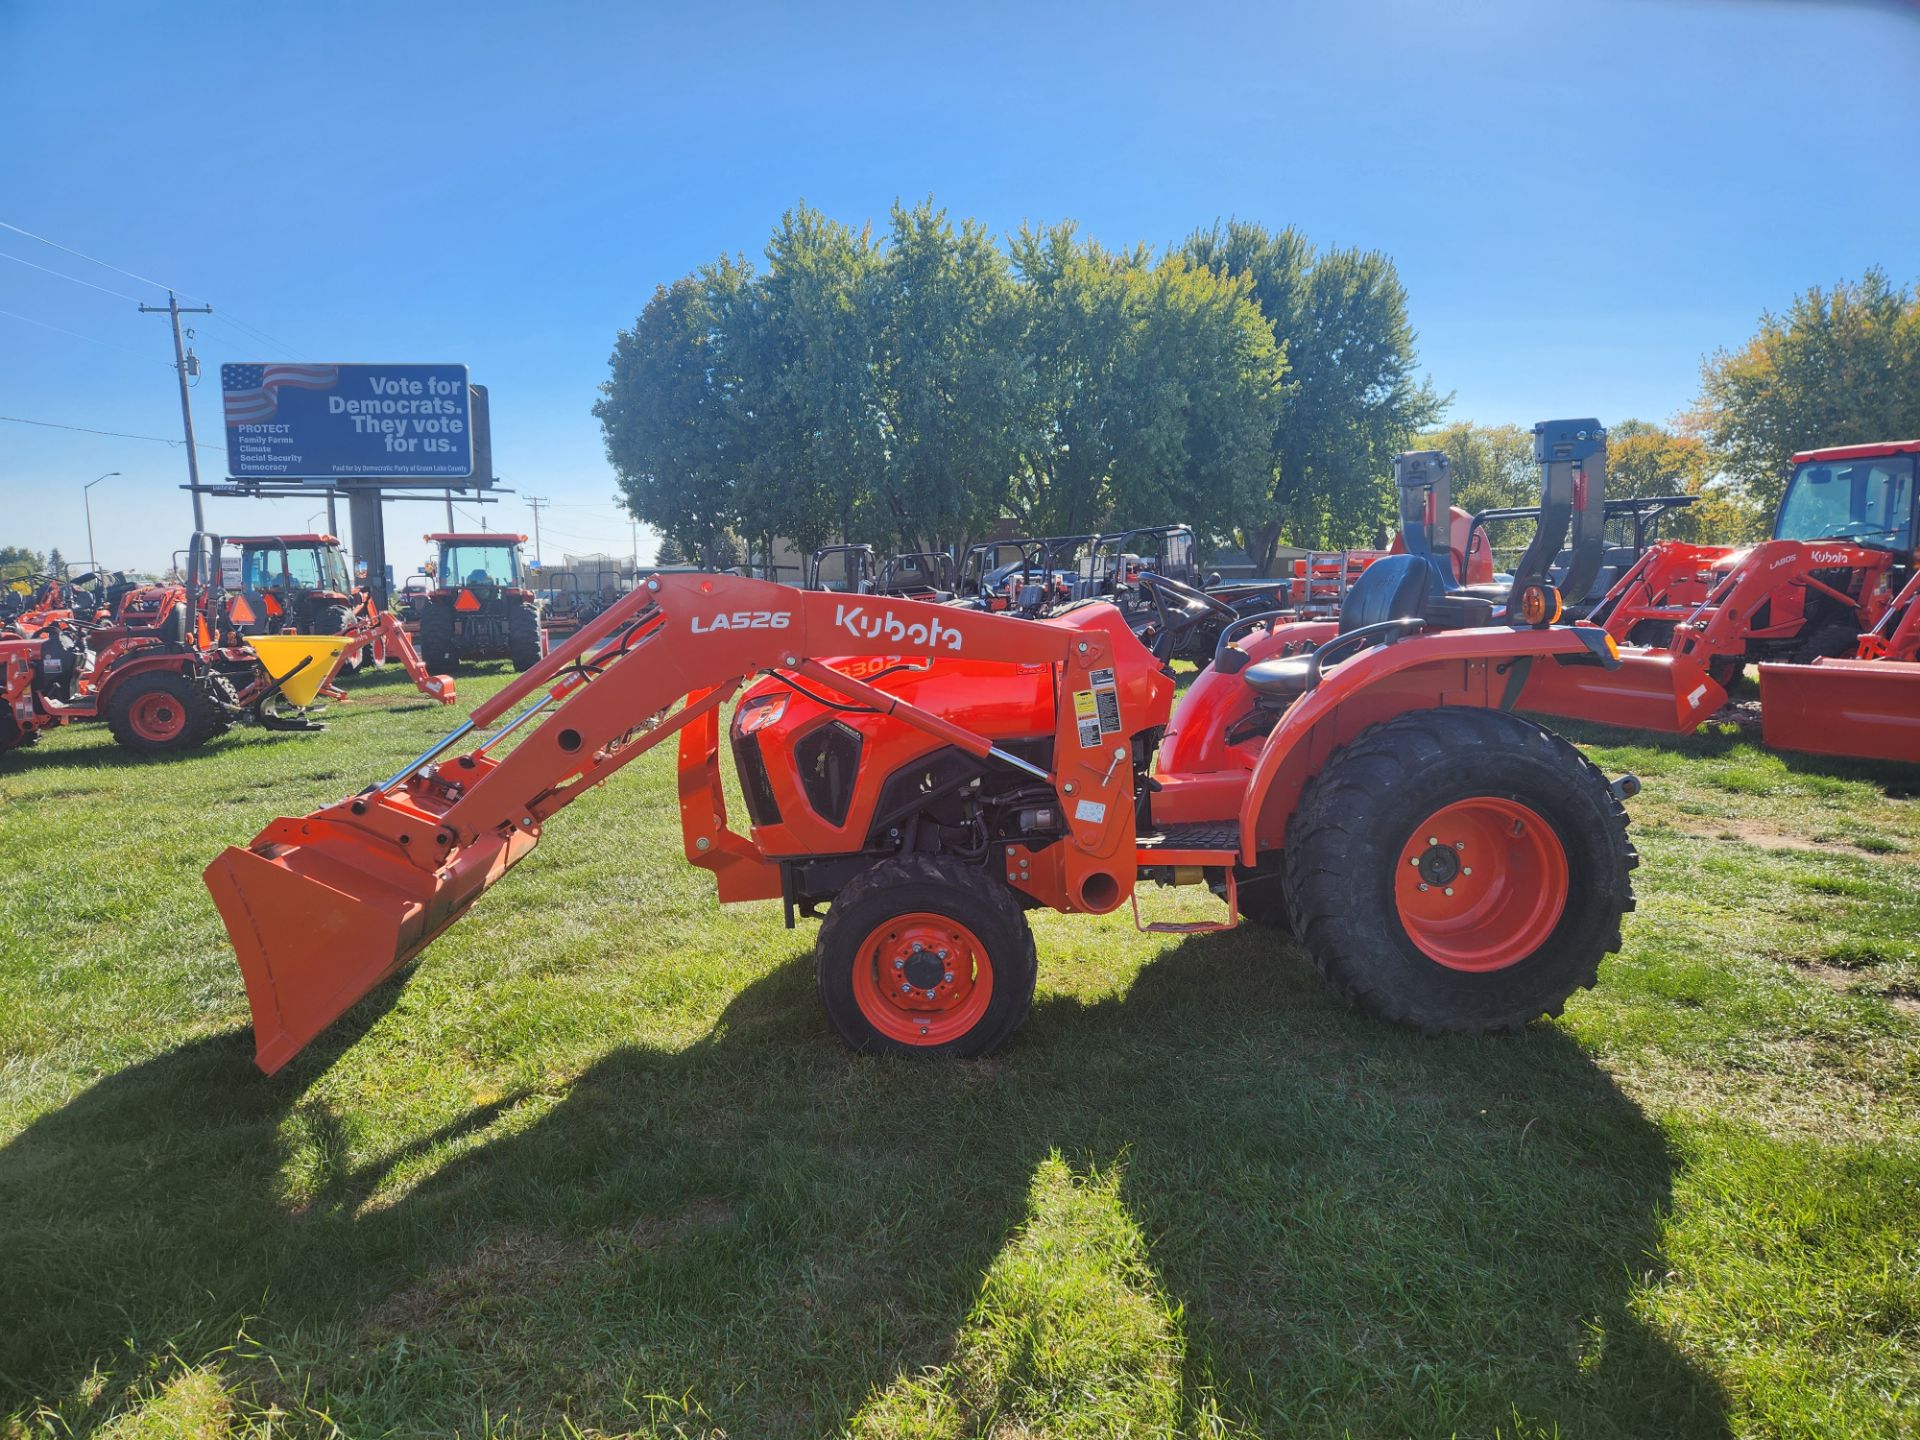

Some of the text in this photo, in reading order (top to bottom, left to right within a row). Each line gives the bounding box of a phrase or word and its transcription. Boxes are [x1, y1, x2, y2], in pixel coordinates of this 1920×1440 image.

[369, 376, 461, 395] Vote for
[329, 396, 462, 414] Democrats.
[238, 424, 290, 433] PROTECT
[351, 415, 463, 437] They vote
[239, 436, 294, 445] Family Farms
[385, 434, 457, 452] for us.
[240, 454, 302, 463] Social Security
[241, 463, 288, 472] Democracy
[354, 464, 361, 472] by
[394, 464, 409, 472] Party
[448, 464, 467, 472] County
[1811, 551, 1848, 564] Kubota
[691, 611, 792, 634] LA526
[835, 604, 963, 651] Kubota
